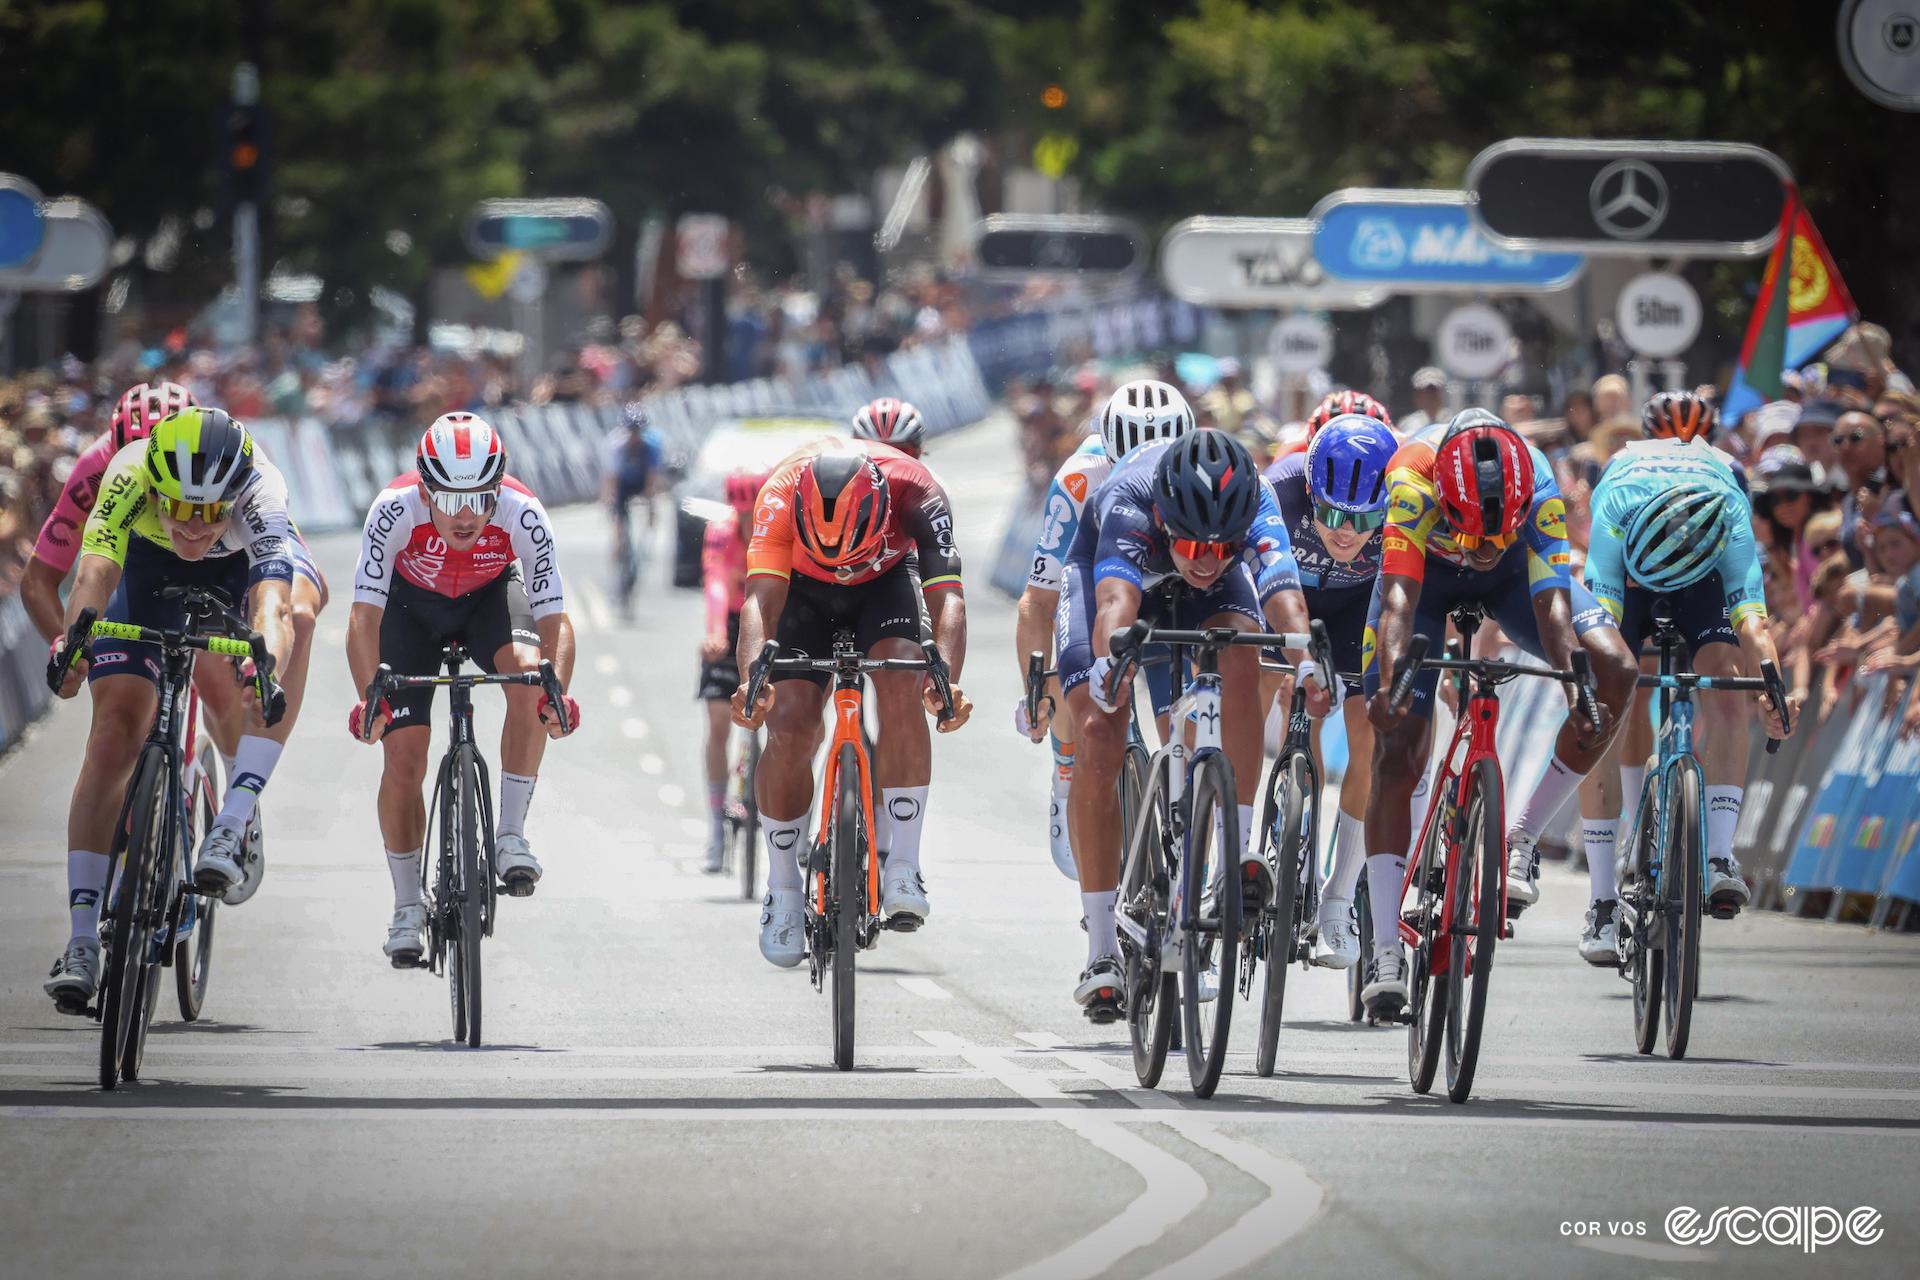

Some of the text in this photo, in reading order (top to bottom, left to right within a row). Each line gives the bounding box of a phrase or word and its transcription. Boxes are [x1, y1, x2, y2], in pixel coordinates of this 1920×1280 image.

[1635, 296, 1683, 327] 50m
[1452, 447, 1468, 503] TREK
[1509, 443, 1522, 499] TREK
[364, 501, 405, 580] Cofidis
[520, 509, 554, 593] Cofidis
[920, 495, 960, 559] INEOS
[159, 682, 175, 733] CUBE
